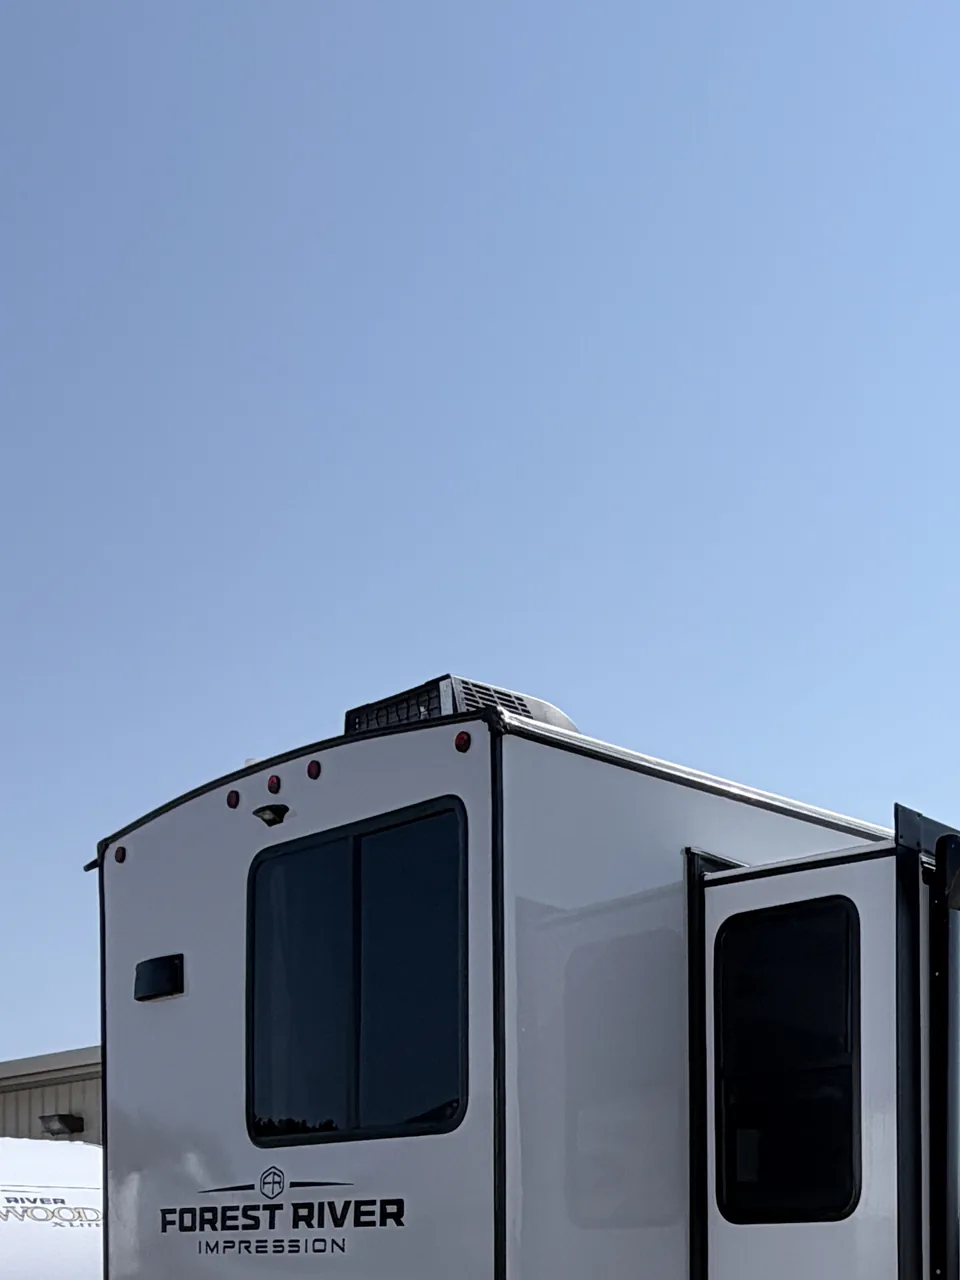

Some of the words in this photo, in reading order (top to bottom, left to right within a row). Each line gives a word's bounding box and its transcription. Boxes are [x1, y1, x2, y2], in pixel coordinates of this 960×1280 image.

[5, 1197, 66, 1205] RIVER
[160, 1204, 283, 1233] FOREST
[291, 1198, 405, 1229] RIVER
[198, 1238, 346, 1254] IMPRESSION
